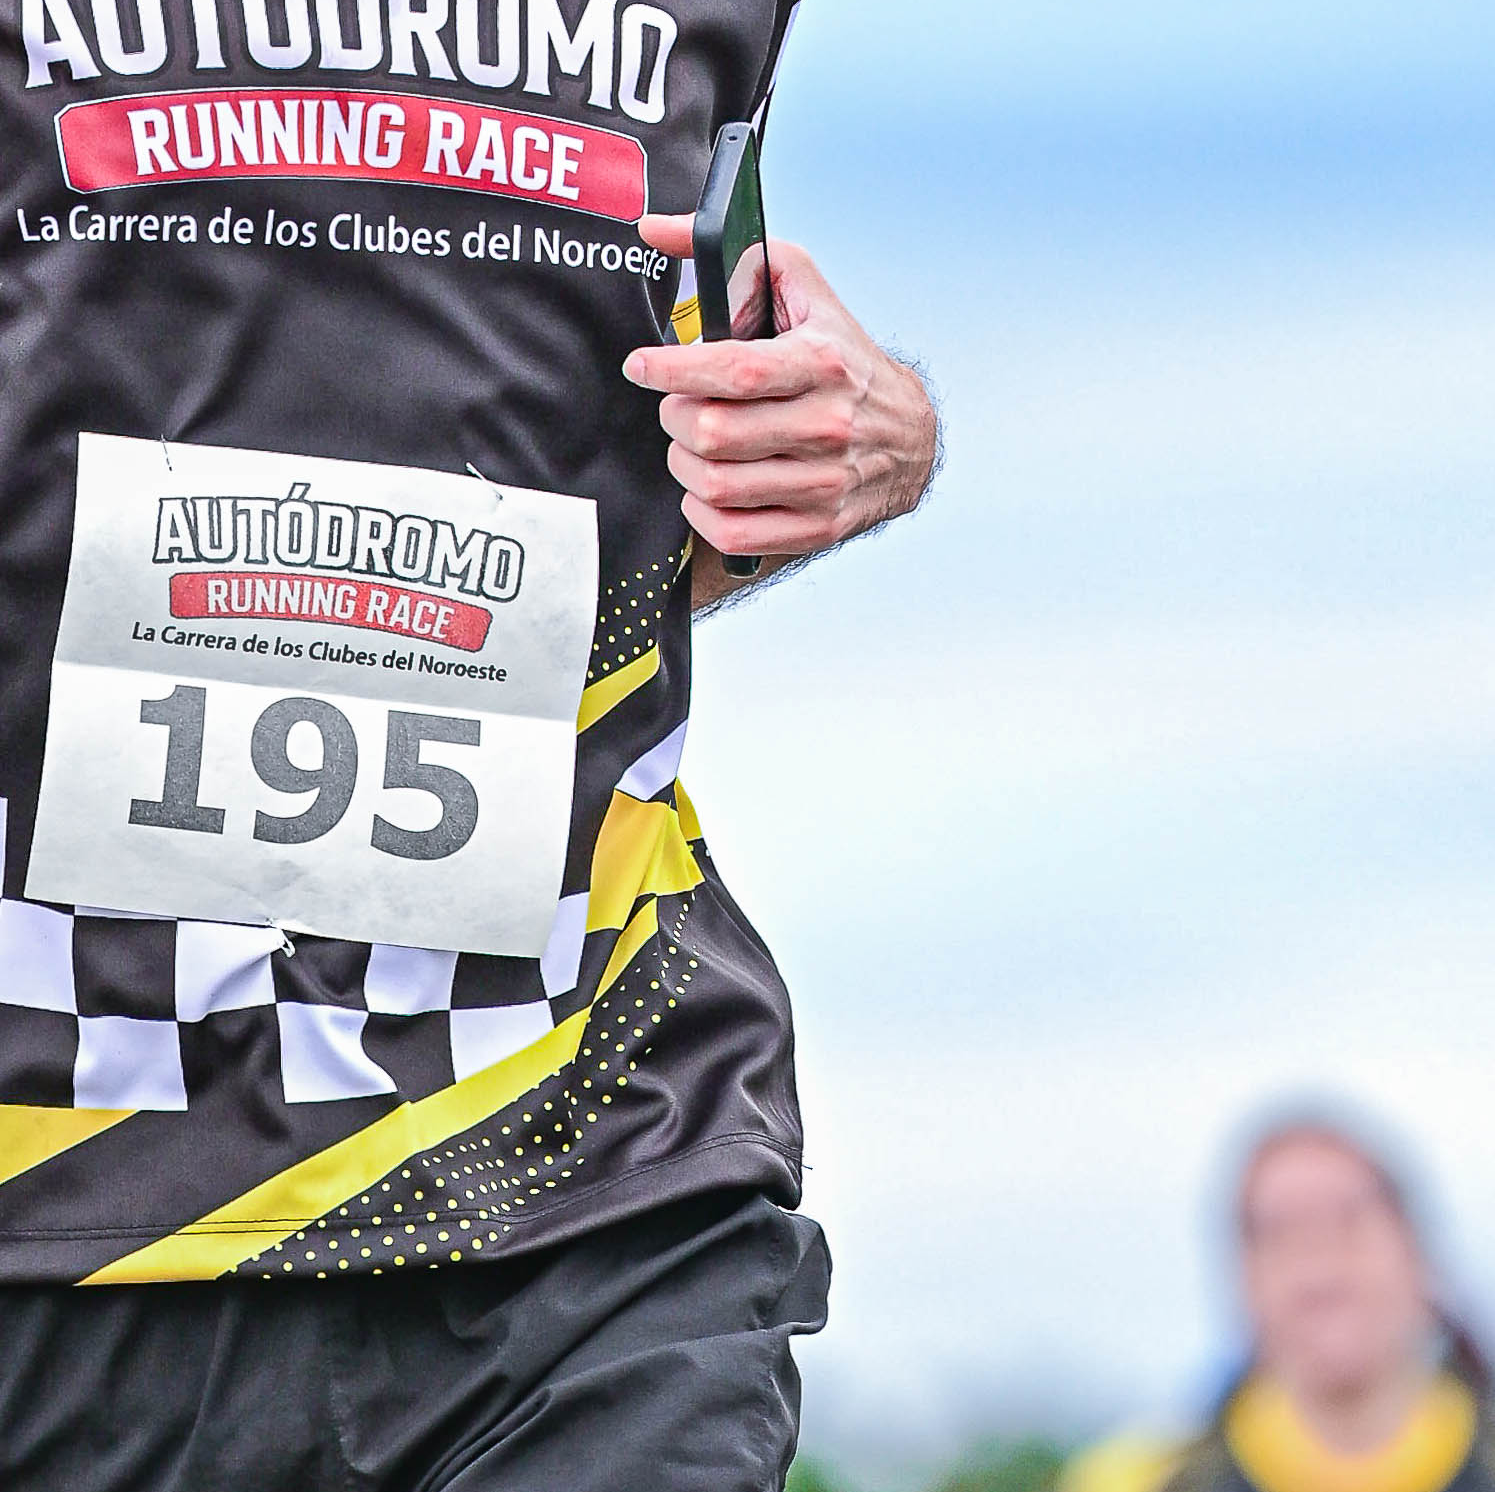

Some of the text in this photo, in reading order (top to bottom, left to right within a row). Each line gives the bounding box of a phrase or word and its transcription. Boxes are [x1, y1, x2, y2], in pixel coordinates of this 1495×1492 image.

[127, 98, 583, 199] RUNNING RACE
[18, 205, 668, 281] La Carrera de los Clubes del Noroeste
[152, 482, 524, 603] AUTÓDROMO
[132, 622, 507, 682] La Carrera de los Clubes del Noroeste
[207, 578, 454, 640] RUNNING RACE
[128, 684, 481, 861] 195
